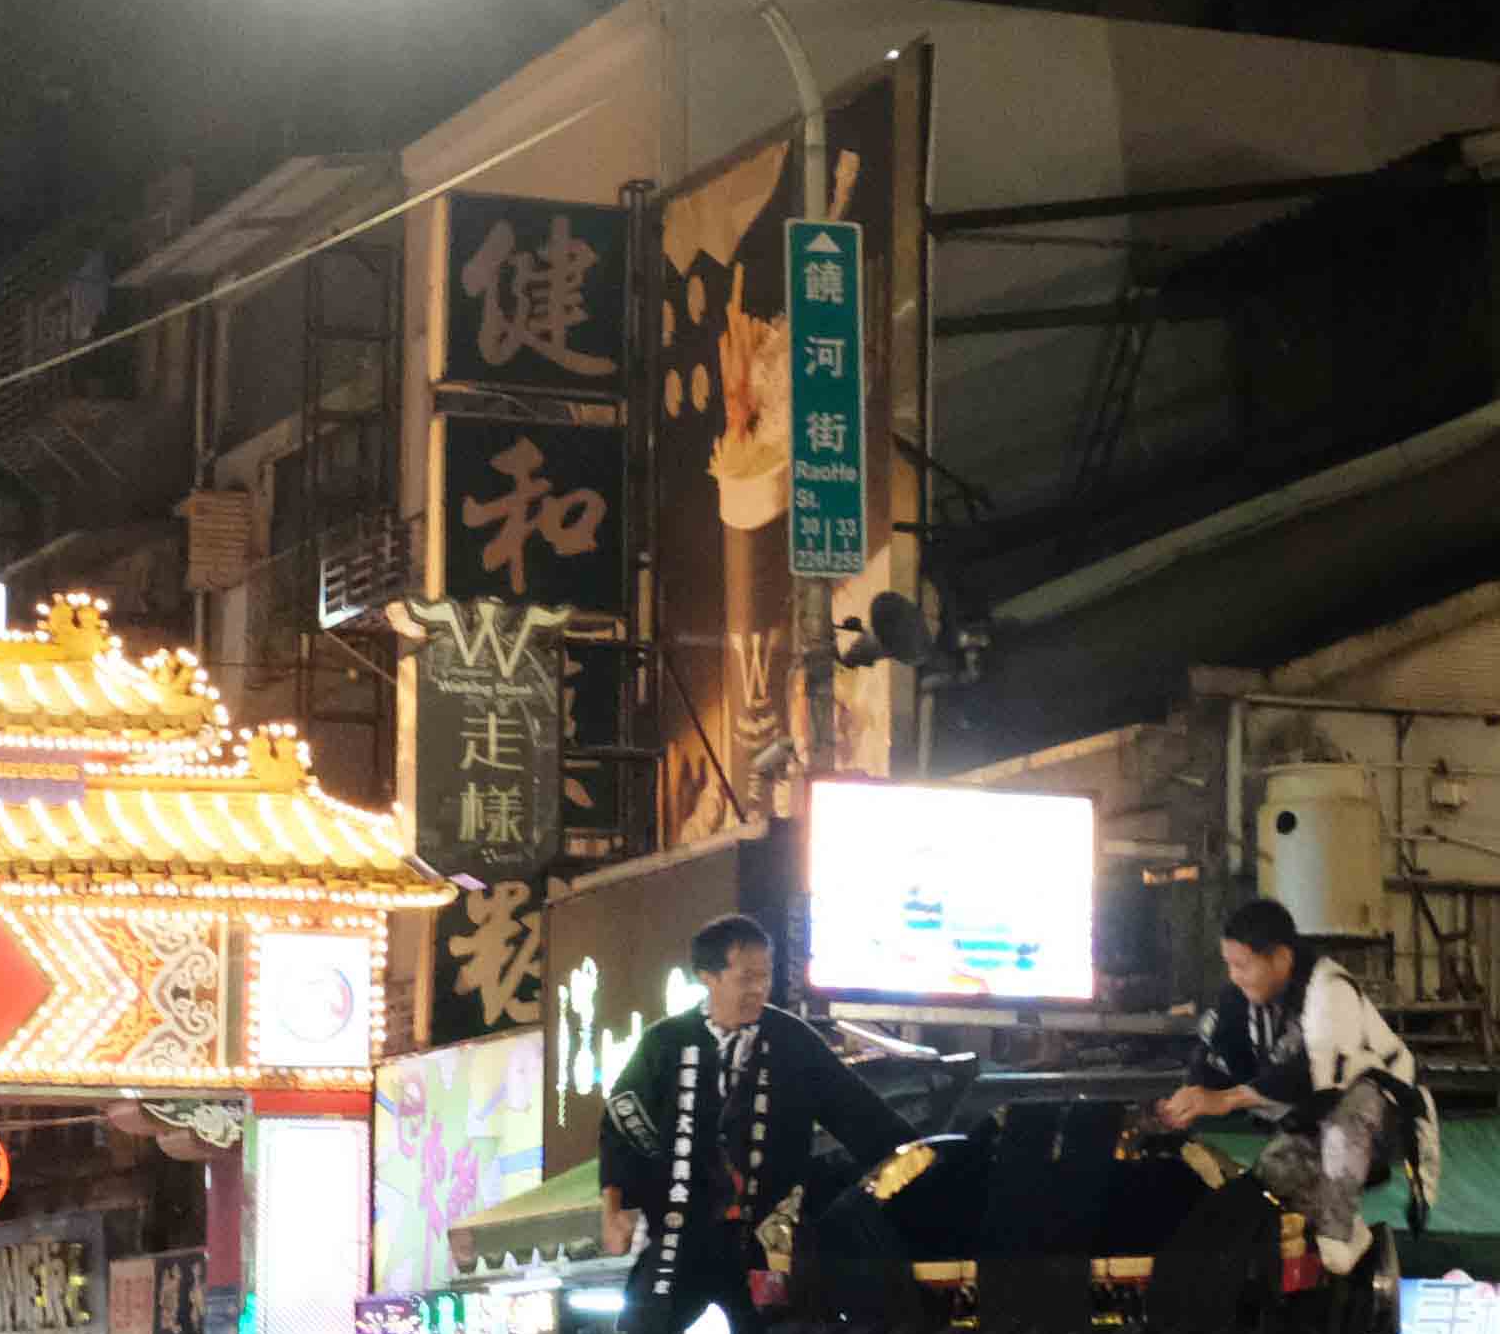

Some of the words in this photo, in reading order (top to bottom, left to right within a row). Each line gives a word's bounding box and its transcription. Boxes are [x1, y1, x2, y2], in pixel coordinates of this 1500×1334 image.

[804, 260, 847, 454] 饒河街
[459, 712, 525, 843] 走樣
